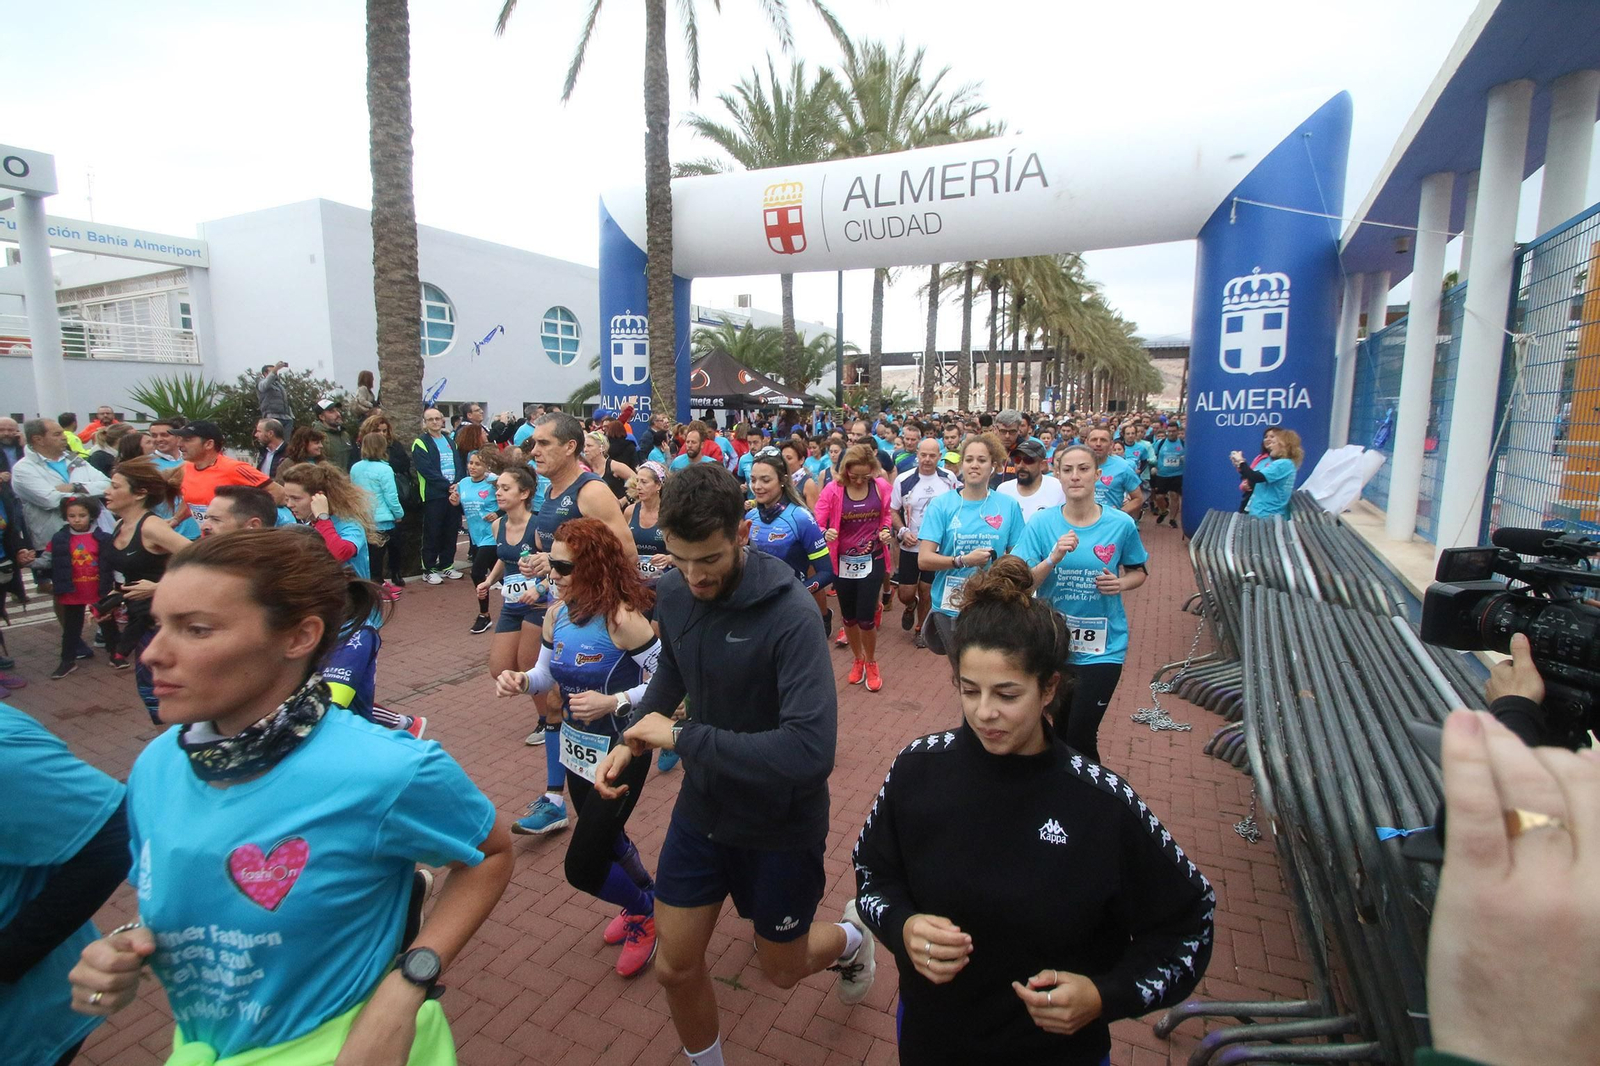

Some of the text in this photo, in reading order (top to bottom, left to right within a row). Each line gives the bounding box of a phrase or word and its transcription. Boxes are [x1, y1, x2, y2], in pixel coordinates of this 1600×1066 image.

[3, 156, 29, 177] O
[842, 148, 1050, 211] ALMERÍA
[844, 212, 942, 242] CIUDAD
[133, 238, 202, 258] Almeriport
[1195, 383, 1312, 412] ALMERÍA
[1215, 412, 1283, 427] CIUDAD
[846, 562, 866, 571] 735
[1058, 567, 1083, 575] Runner
[507, 582, 528, 594] 701
[565, 738, 598, 765] 365
[1040, 830, 1067, 845] Kappa
